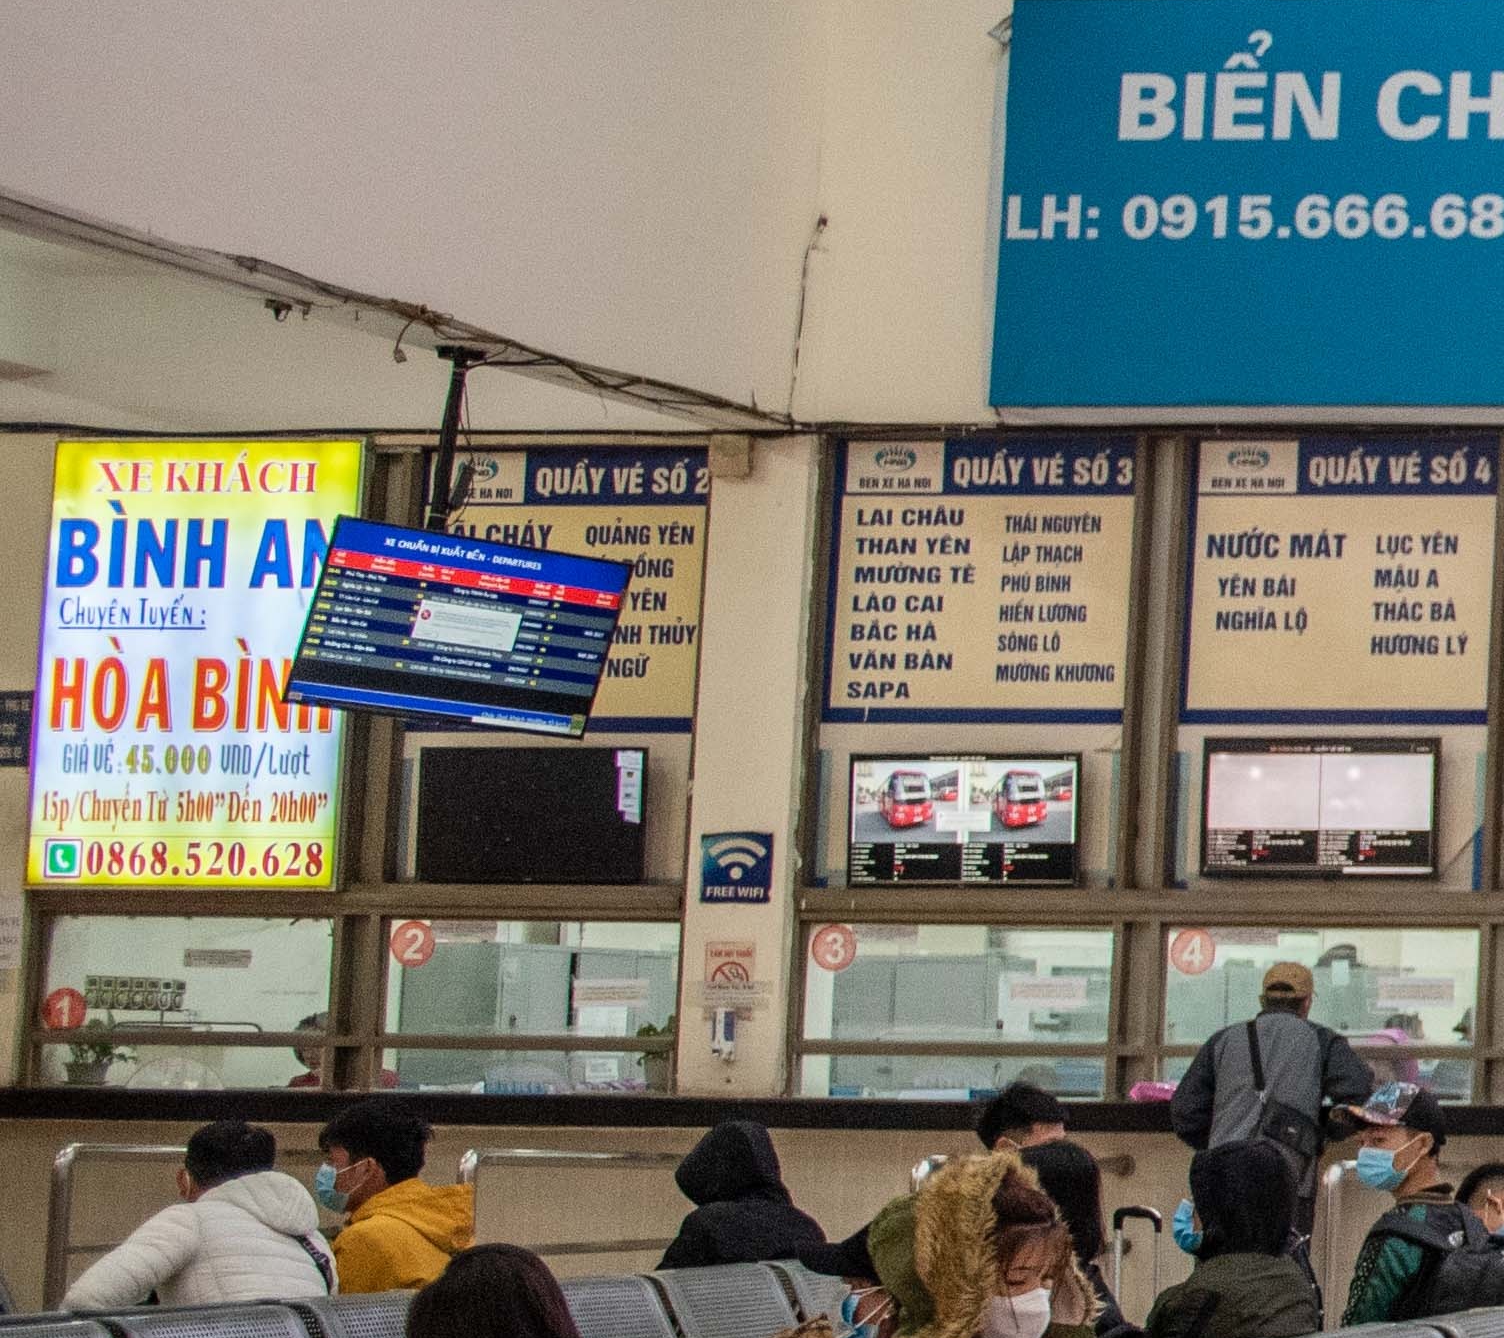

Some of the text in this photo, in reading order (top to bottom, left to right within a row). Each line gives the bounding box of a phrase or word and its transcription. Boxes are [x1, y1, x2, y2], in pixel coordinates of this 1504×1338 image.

[1117, 31, 1342, 142] BIỂN
[1005, 196, 1100, 241] LH:
[97, 449, 318, 494] XE KHÁCH
[613, 460, 645, 494] VÉ
[652, 458, 689, 495] SỐ
[695, 469, 709, 491] 2
[1032, 451, 1064, 486] VÉ
[1073, 448, 1110, 486] SỐ
[1117, 458, 1133, 486] 3
[586, 519, 695, 546] QUẢNG YÊN
[856, 508, 893, 527] LAI
[56, 499, 230, 590] BÌNH
[856, 533, 971, 555] THAN YÊN
[905, 594, 944, 612] CAI
[49, 636, 173, 733] HÒA
[846, 681, 910, 700] SAPA
[126, 744, 211, 774] 45.000
[86, 841, 323, 878] 0868.520.628
[706, 886, 764, 899] FREE WIFI
[403, 931, 425, 959] 2
[823, 932, 845, 962] 3
[1181, 936, 1203, 964] 4
[56, 996, 74, 1026] 1
